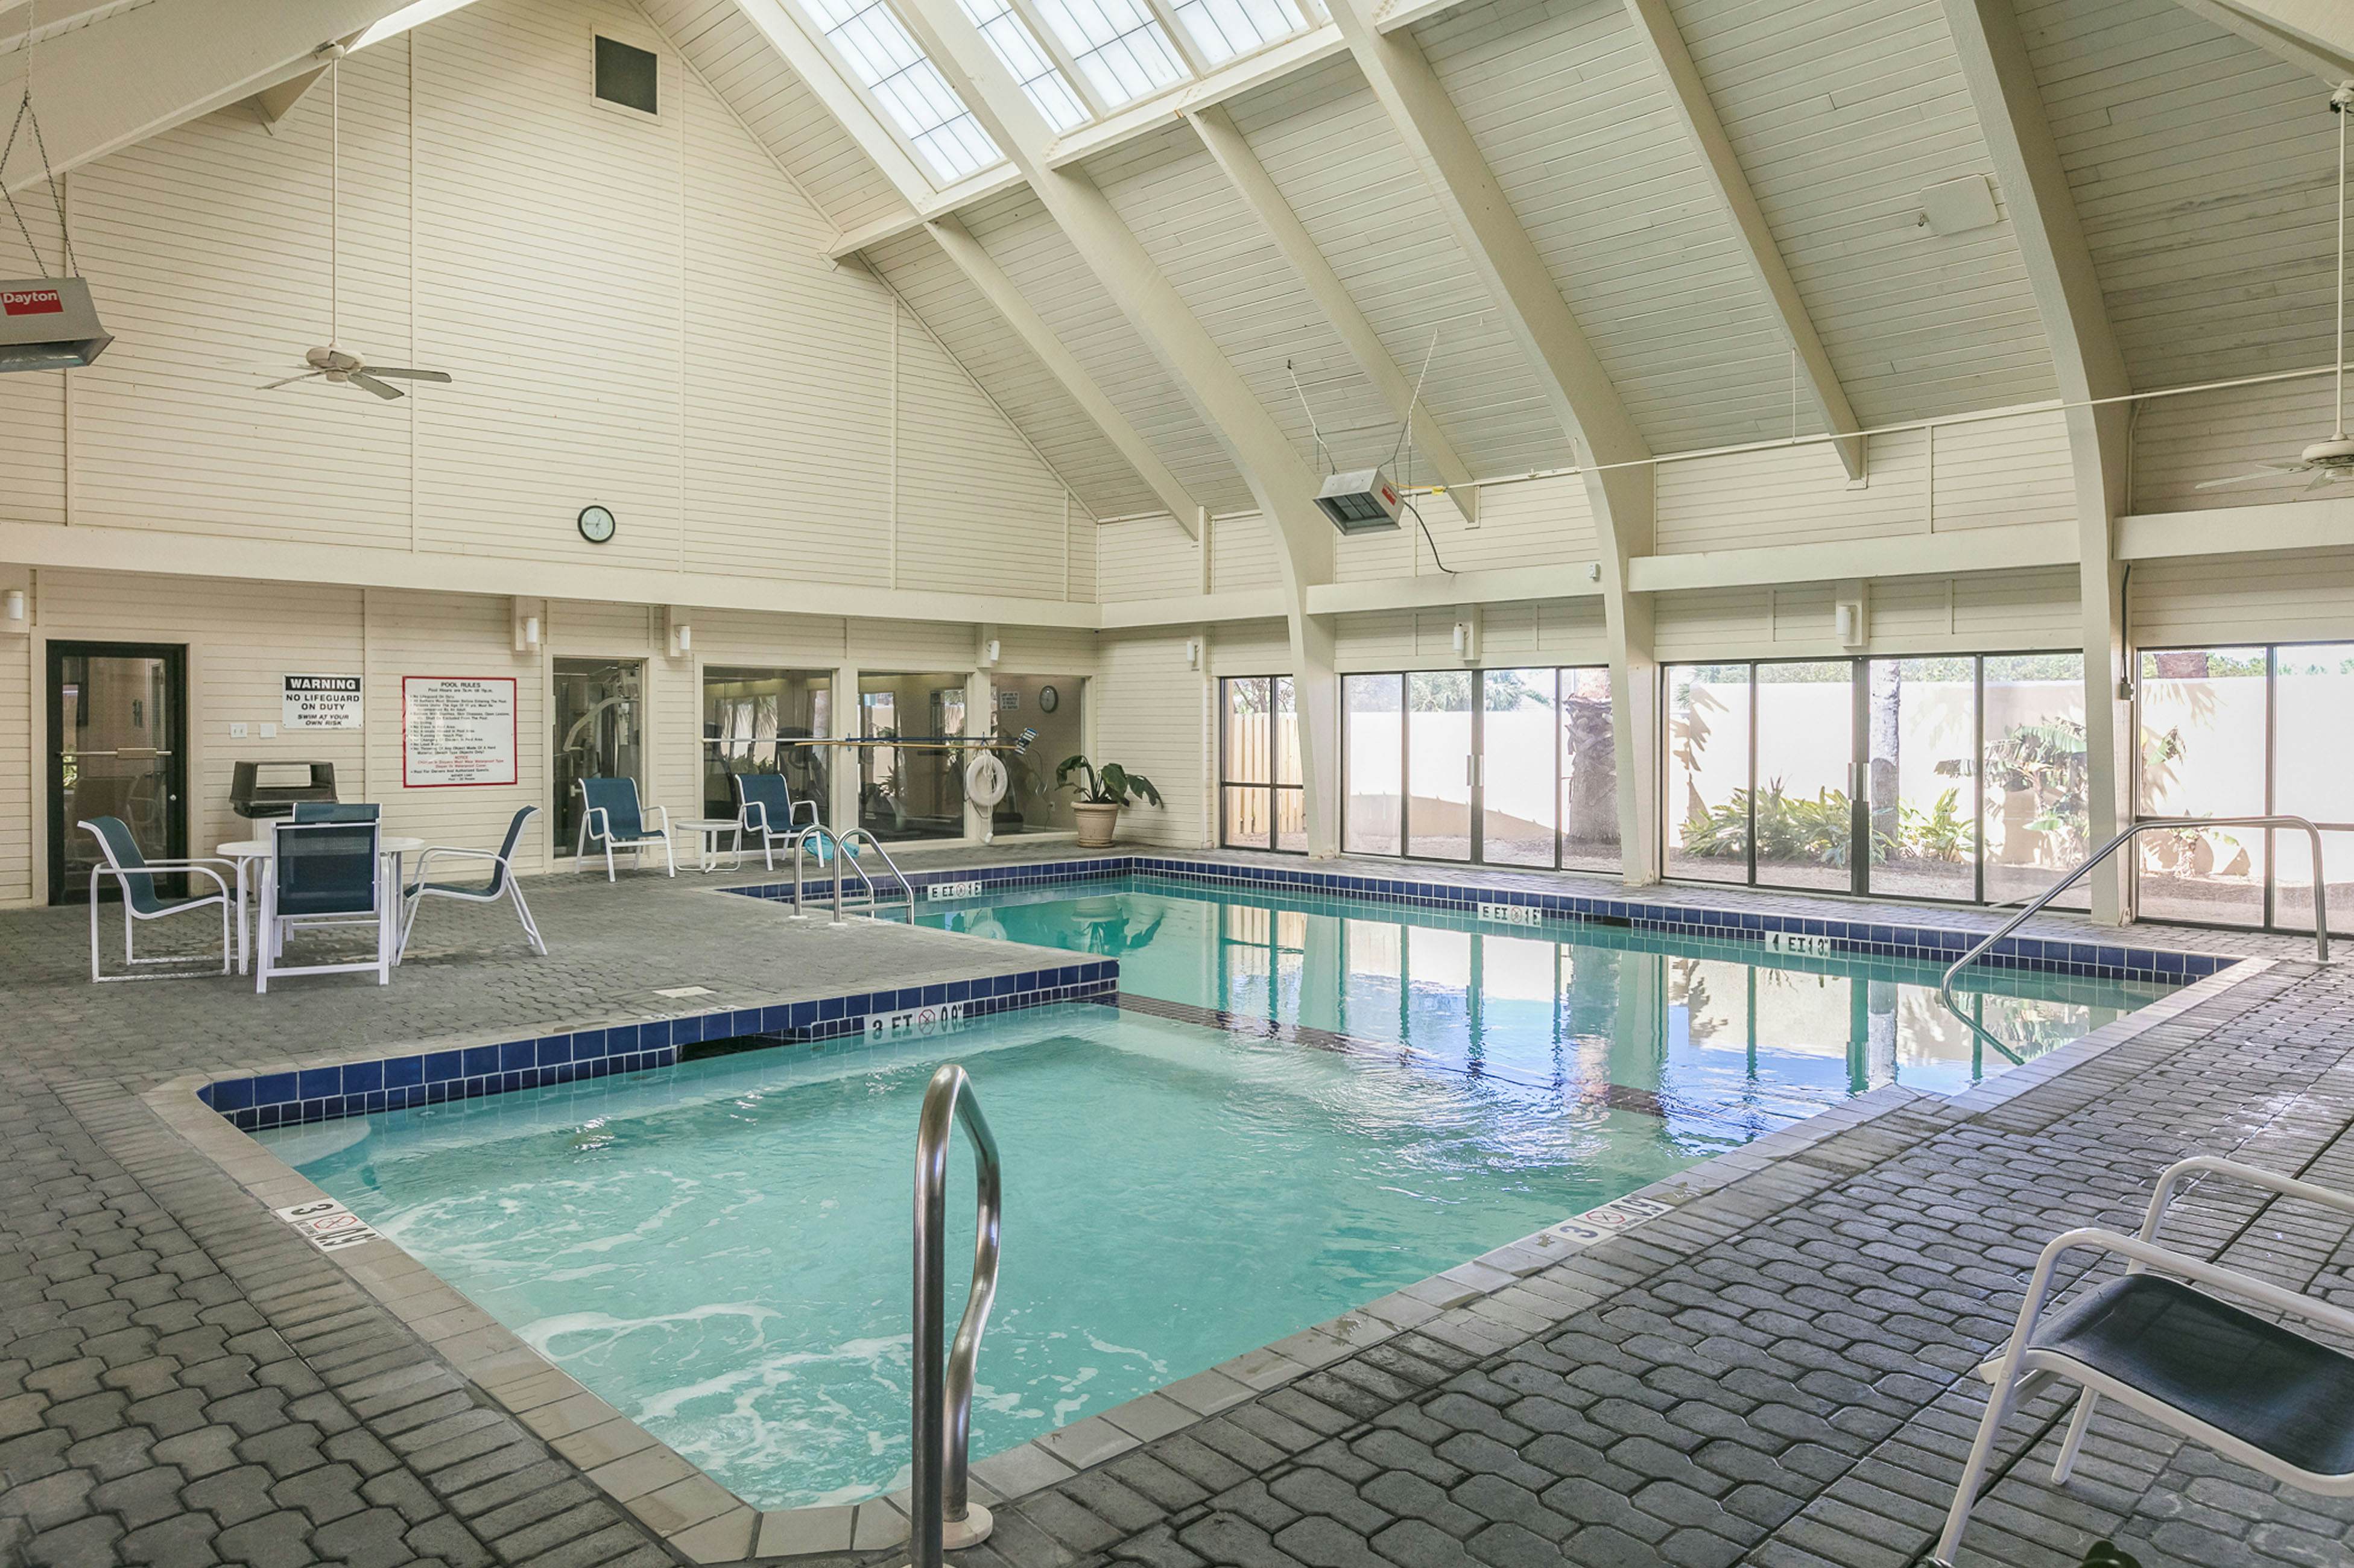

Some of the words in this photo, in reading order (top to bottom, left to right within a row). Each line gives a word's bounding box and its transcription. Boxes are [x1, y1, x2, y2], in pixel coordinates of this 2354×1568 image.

[3, 292, 58, 305] Dayton
[290, 678, 356, 689] WARNING
[291, 1203, 334, 1215] 3
[1560, 1225, 1599, 1239] 3
